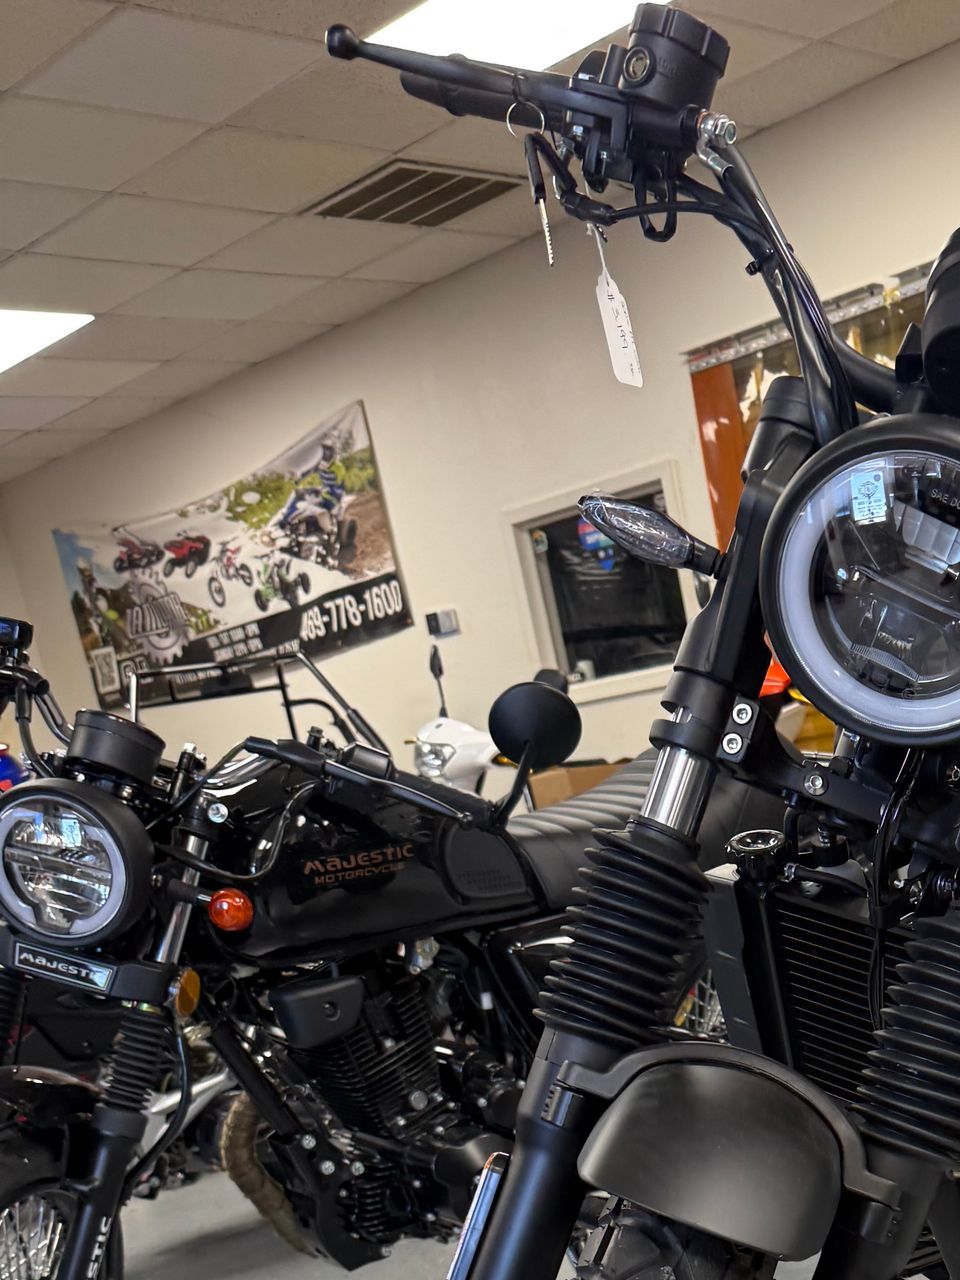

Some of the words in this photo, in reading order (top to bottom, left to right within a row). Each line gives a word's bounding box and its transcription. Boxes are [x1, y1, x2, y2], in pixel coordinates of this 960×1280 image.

[931, 488, 949, 503] SAE
[300, 580, 403, 641] 469-778-1600
[314, 862, 407, 885] MOTORCYCLE
